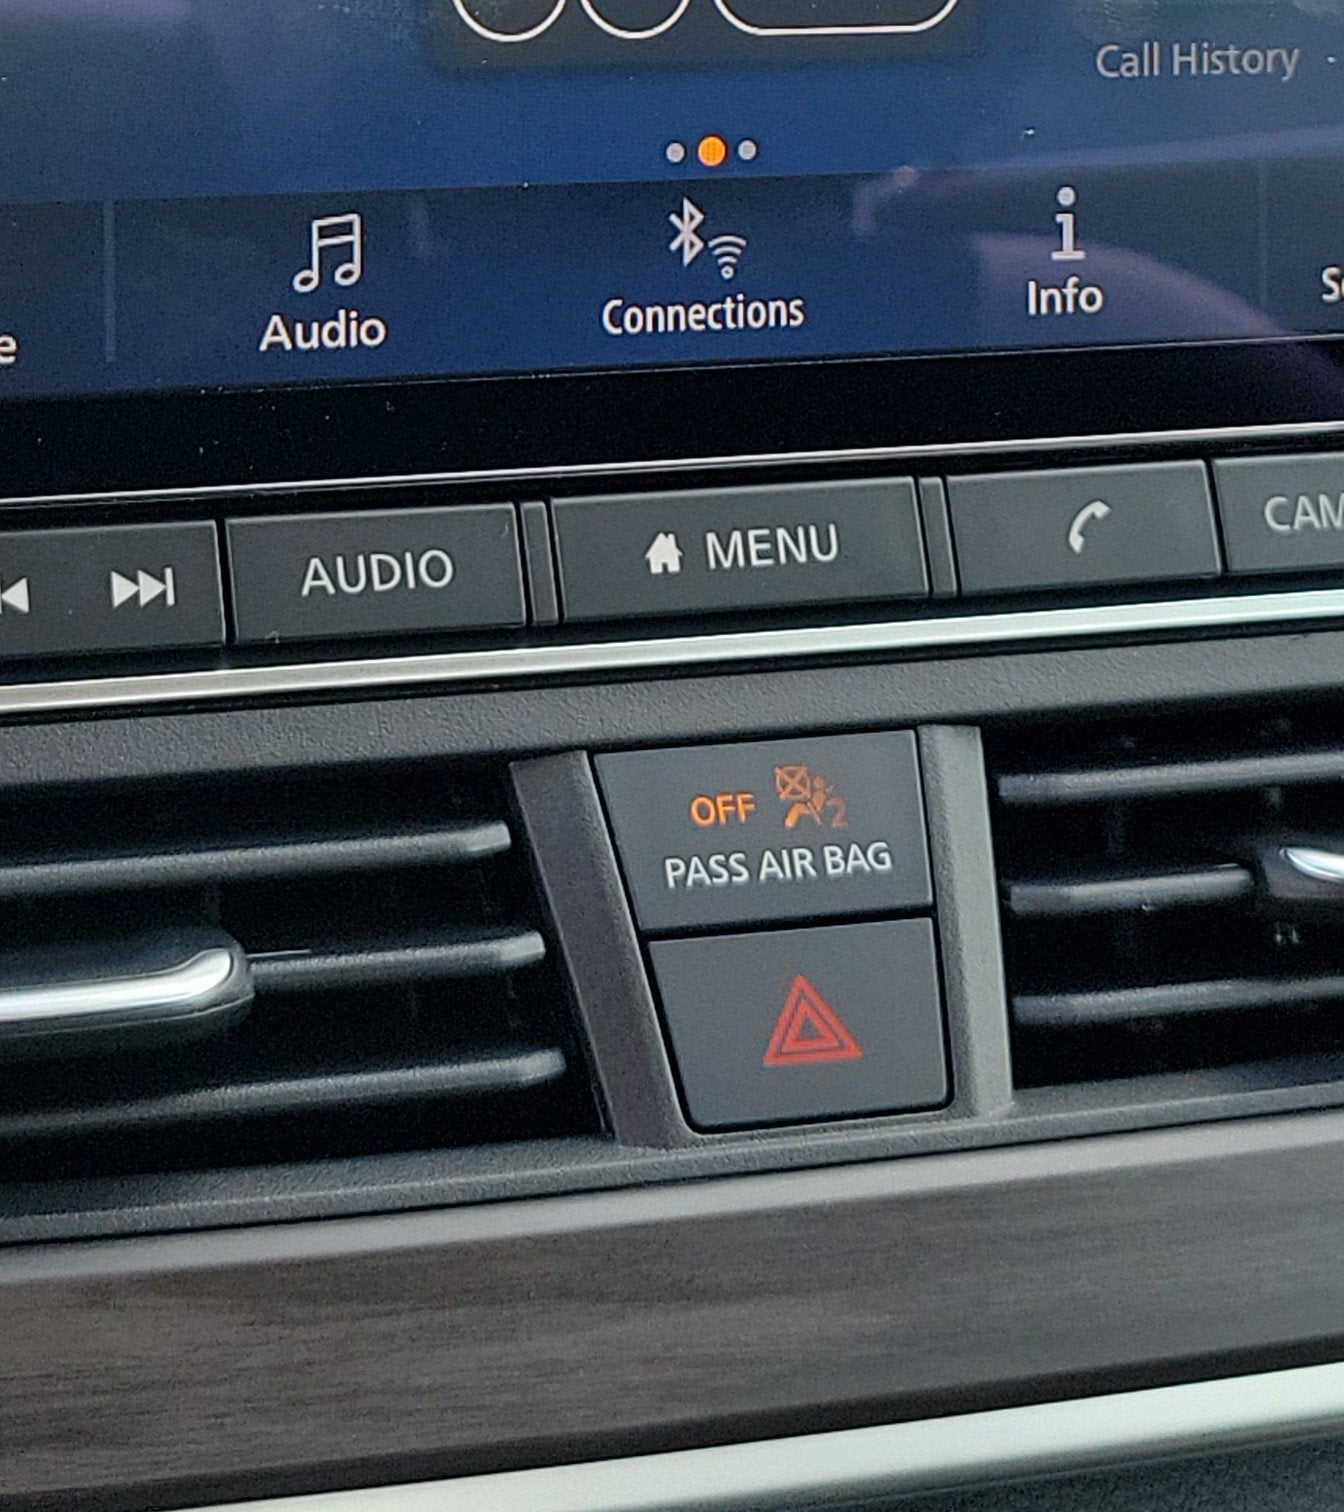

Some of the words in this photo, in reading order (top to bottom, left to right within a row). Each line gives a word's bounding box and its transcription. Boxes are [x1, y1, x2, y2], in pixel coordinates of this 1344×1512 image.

[1095, 43, 1162, 79] Call
[1171, 41, 1300, 82] History
[601, 292, 805, 337] Connections
[1027, 276, 1104, 317] Info
[258, 313, 388, 354] Audio
[706, 524, 840, 570] MENU
[300, 550, 454, 598] AUDIO
[690, 793, 756, 827] OFF
[664, 851, 749, 889] PASS
[758, 847, 817, 881] AIR
[824, 839, 893, 874] BAG
